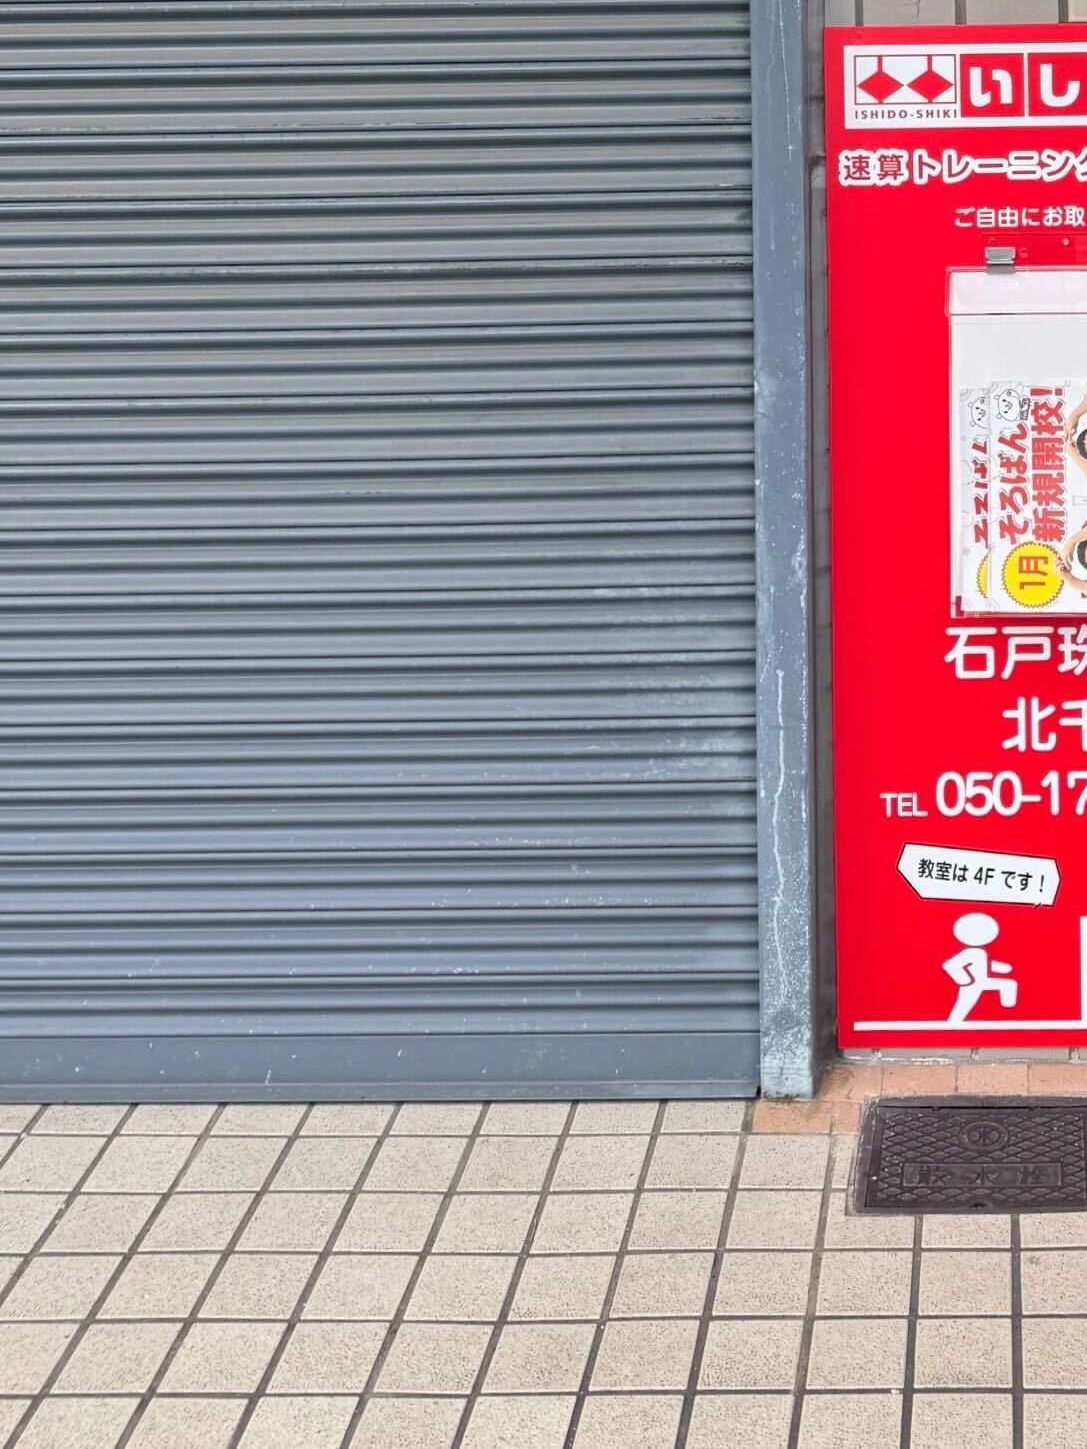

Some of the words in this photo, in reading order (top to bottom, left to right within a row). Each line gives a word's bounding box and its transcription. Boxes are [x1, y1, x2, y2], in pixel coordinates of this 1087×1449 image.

[854, 108, 958, 120] ISHIDO-SHIKI
[998, 422, 1030, 545] そろばん
[1018, 555, 1049, 590] 1月
[880, 792, 928, 818] TEL
